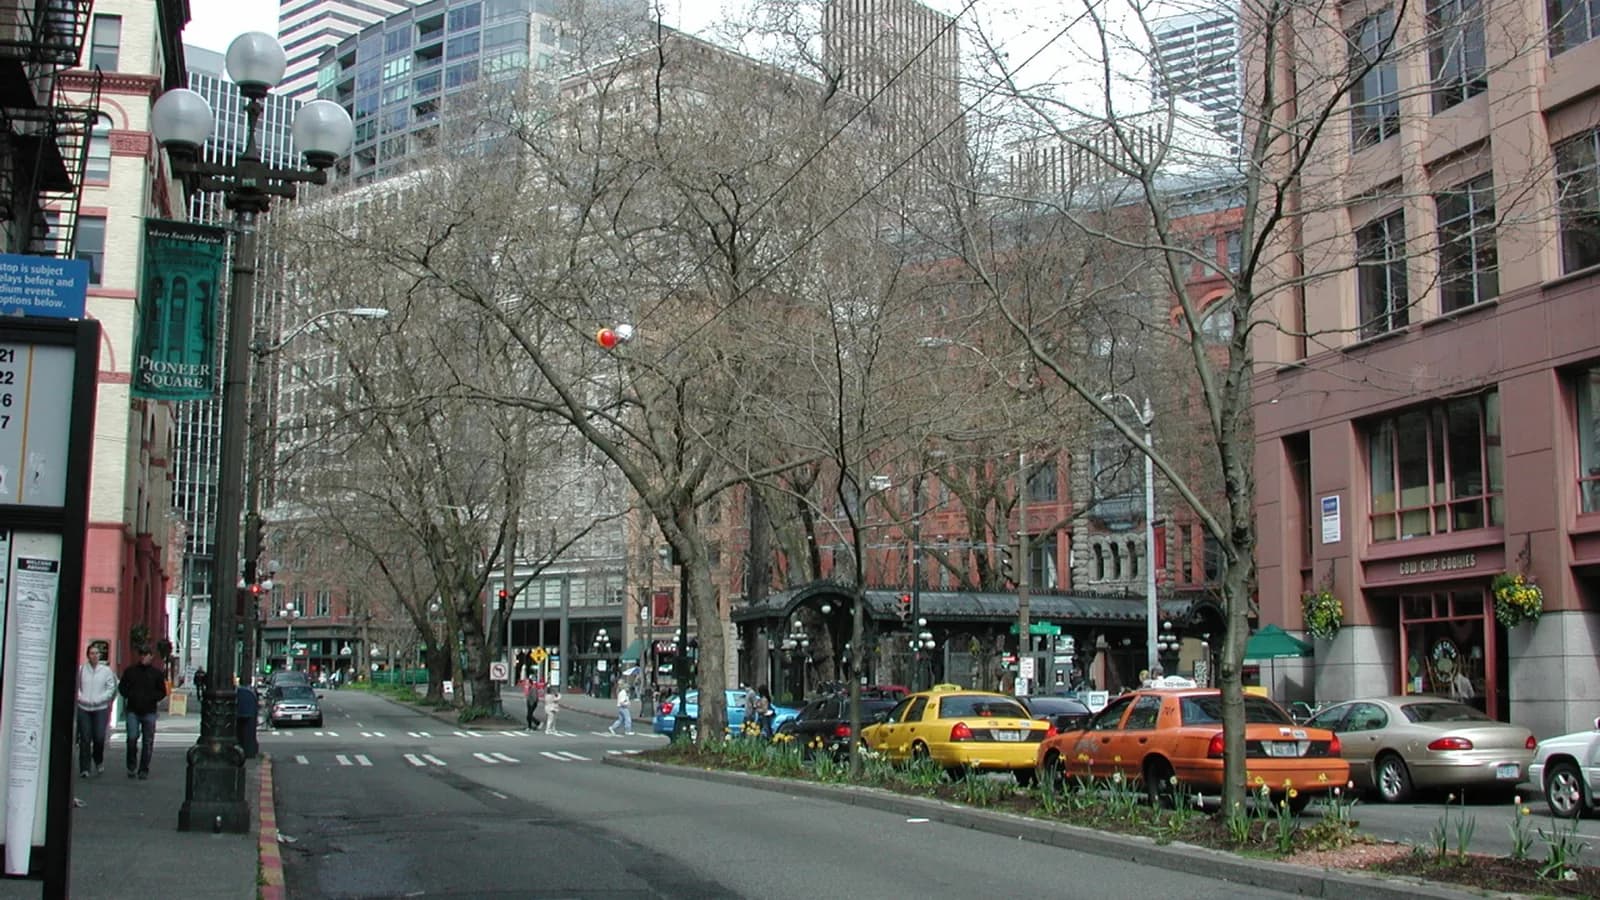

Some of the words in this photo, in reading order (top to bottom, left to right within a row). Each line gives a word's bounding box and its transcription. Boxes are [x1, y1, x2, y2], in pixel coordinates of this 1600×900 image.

[21, 264, 28, 273] is
[31, 264, 63, 277] subject
[24, 275, 54, 285] before
[56, 278, 74, 287] and
[24, 286, 57, 297] events.
[34, 296, 66, 308] below.
[140, 355, 210, 376] PIONEER
[143, 372, 204, 389] SQUARE
[0, 393, 12, 407] 6
[1399, 561, 1417, 575] COW
[1420, 558, 1438, 573] CHIP
[1441, 553, 1477, 571] COOKIES
